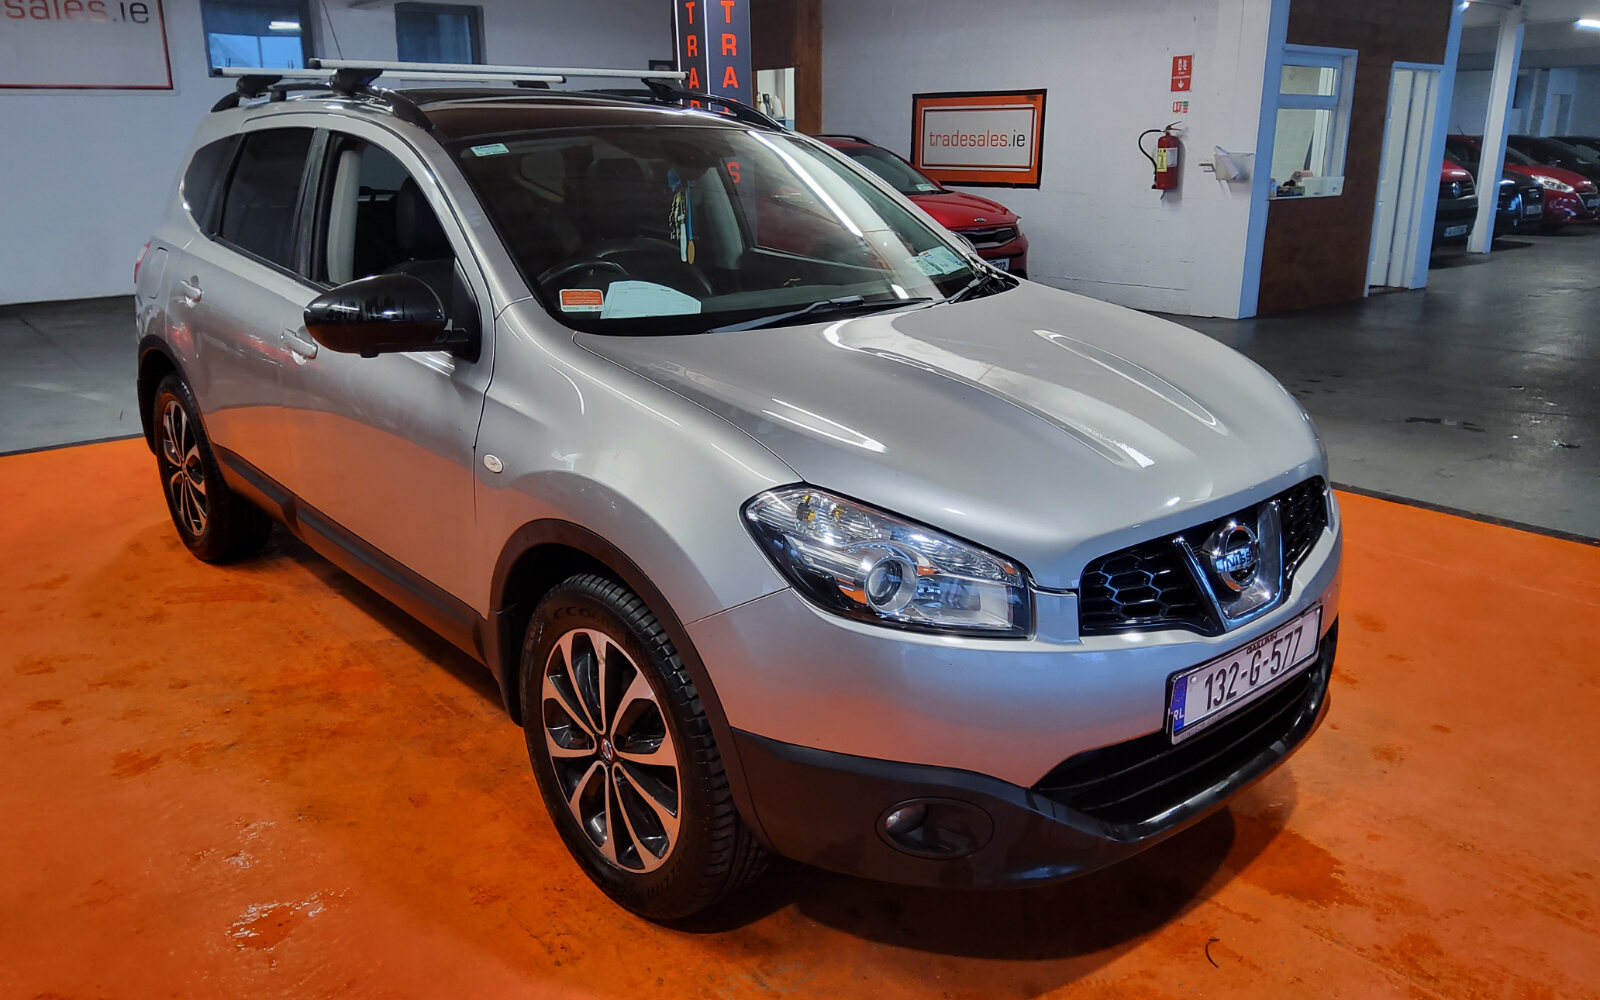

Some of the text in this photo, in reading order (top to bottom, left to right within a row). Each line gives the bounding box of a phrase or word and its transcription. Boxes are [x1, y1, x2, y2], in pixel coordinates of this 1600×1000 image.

[0, 0, 149, 24] sales.ie
[929, 129, 1026, 147] tradesales.ie
[1205, 625, 1303, 711] 132-G-577
